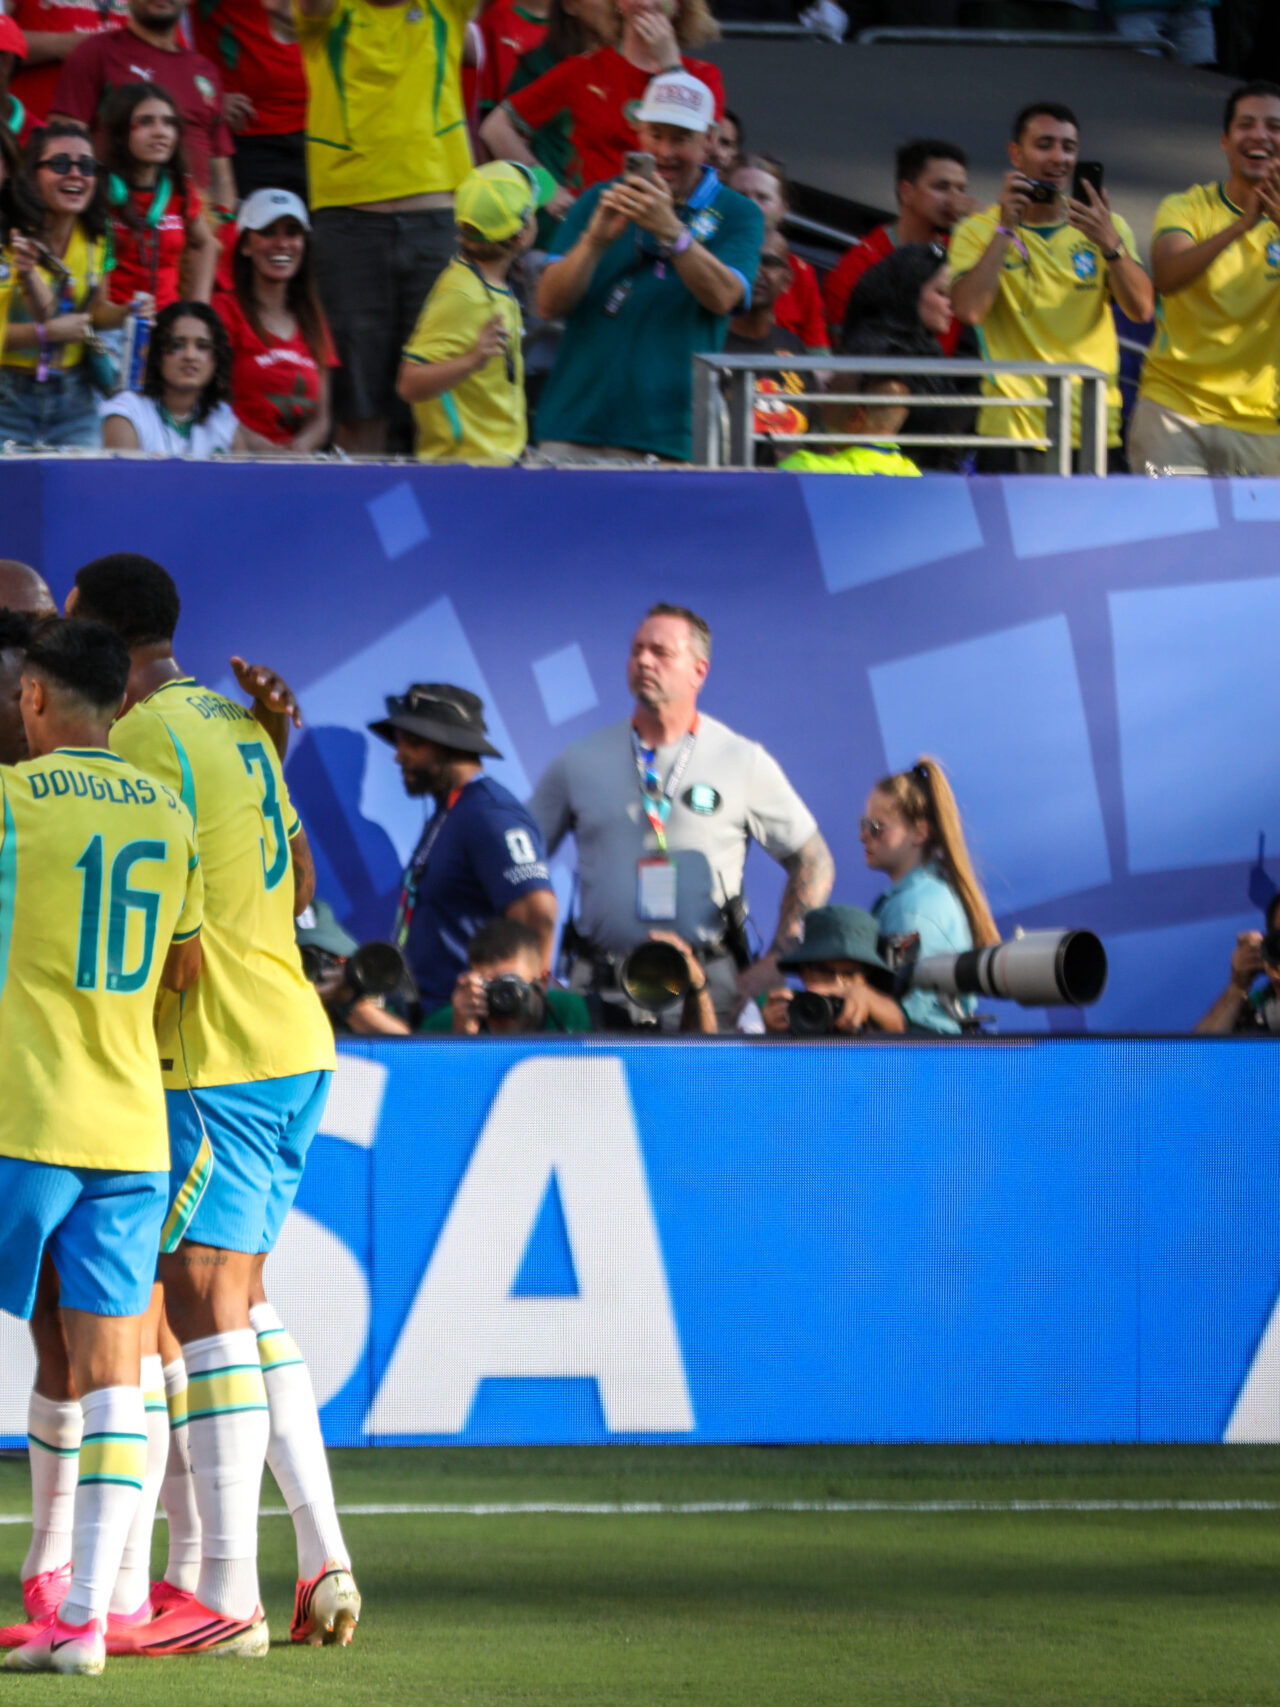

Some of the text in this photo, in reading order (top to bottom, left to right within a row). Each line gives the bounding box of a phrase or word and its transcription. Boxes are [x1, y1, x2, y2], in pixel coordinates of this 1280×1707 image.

[28, 769, 156, 804] DOUGLAS
[234, 741, 290, 892] 3
[72, 832, 167, 994] 16
